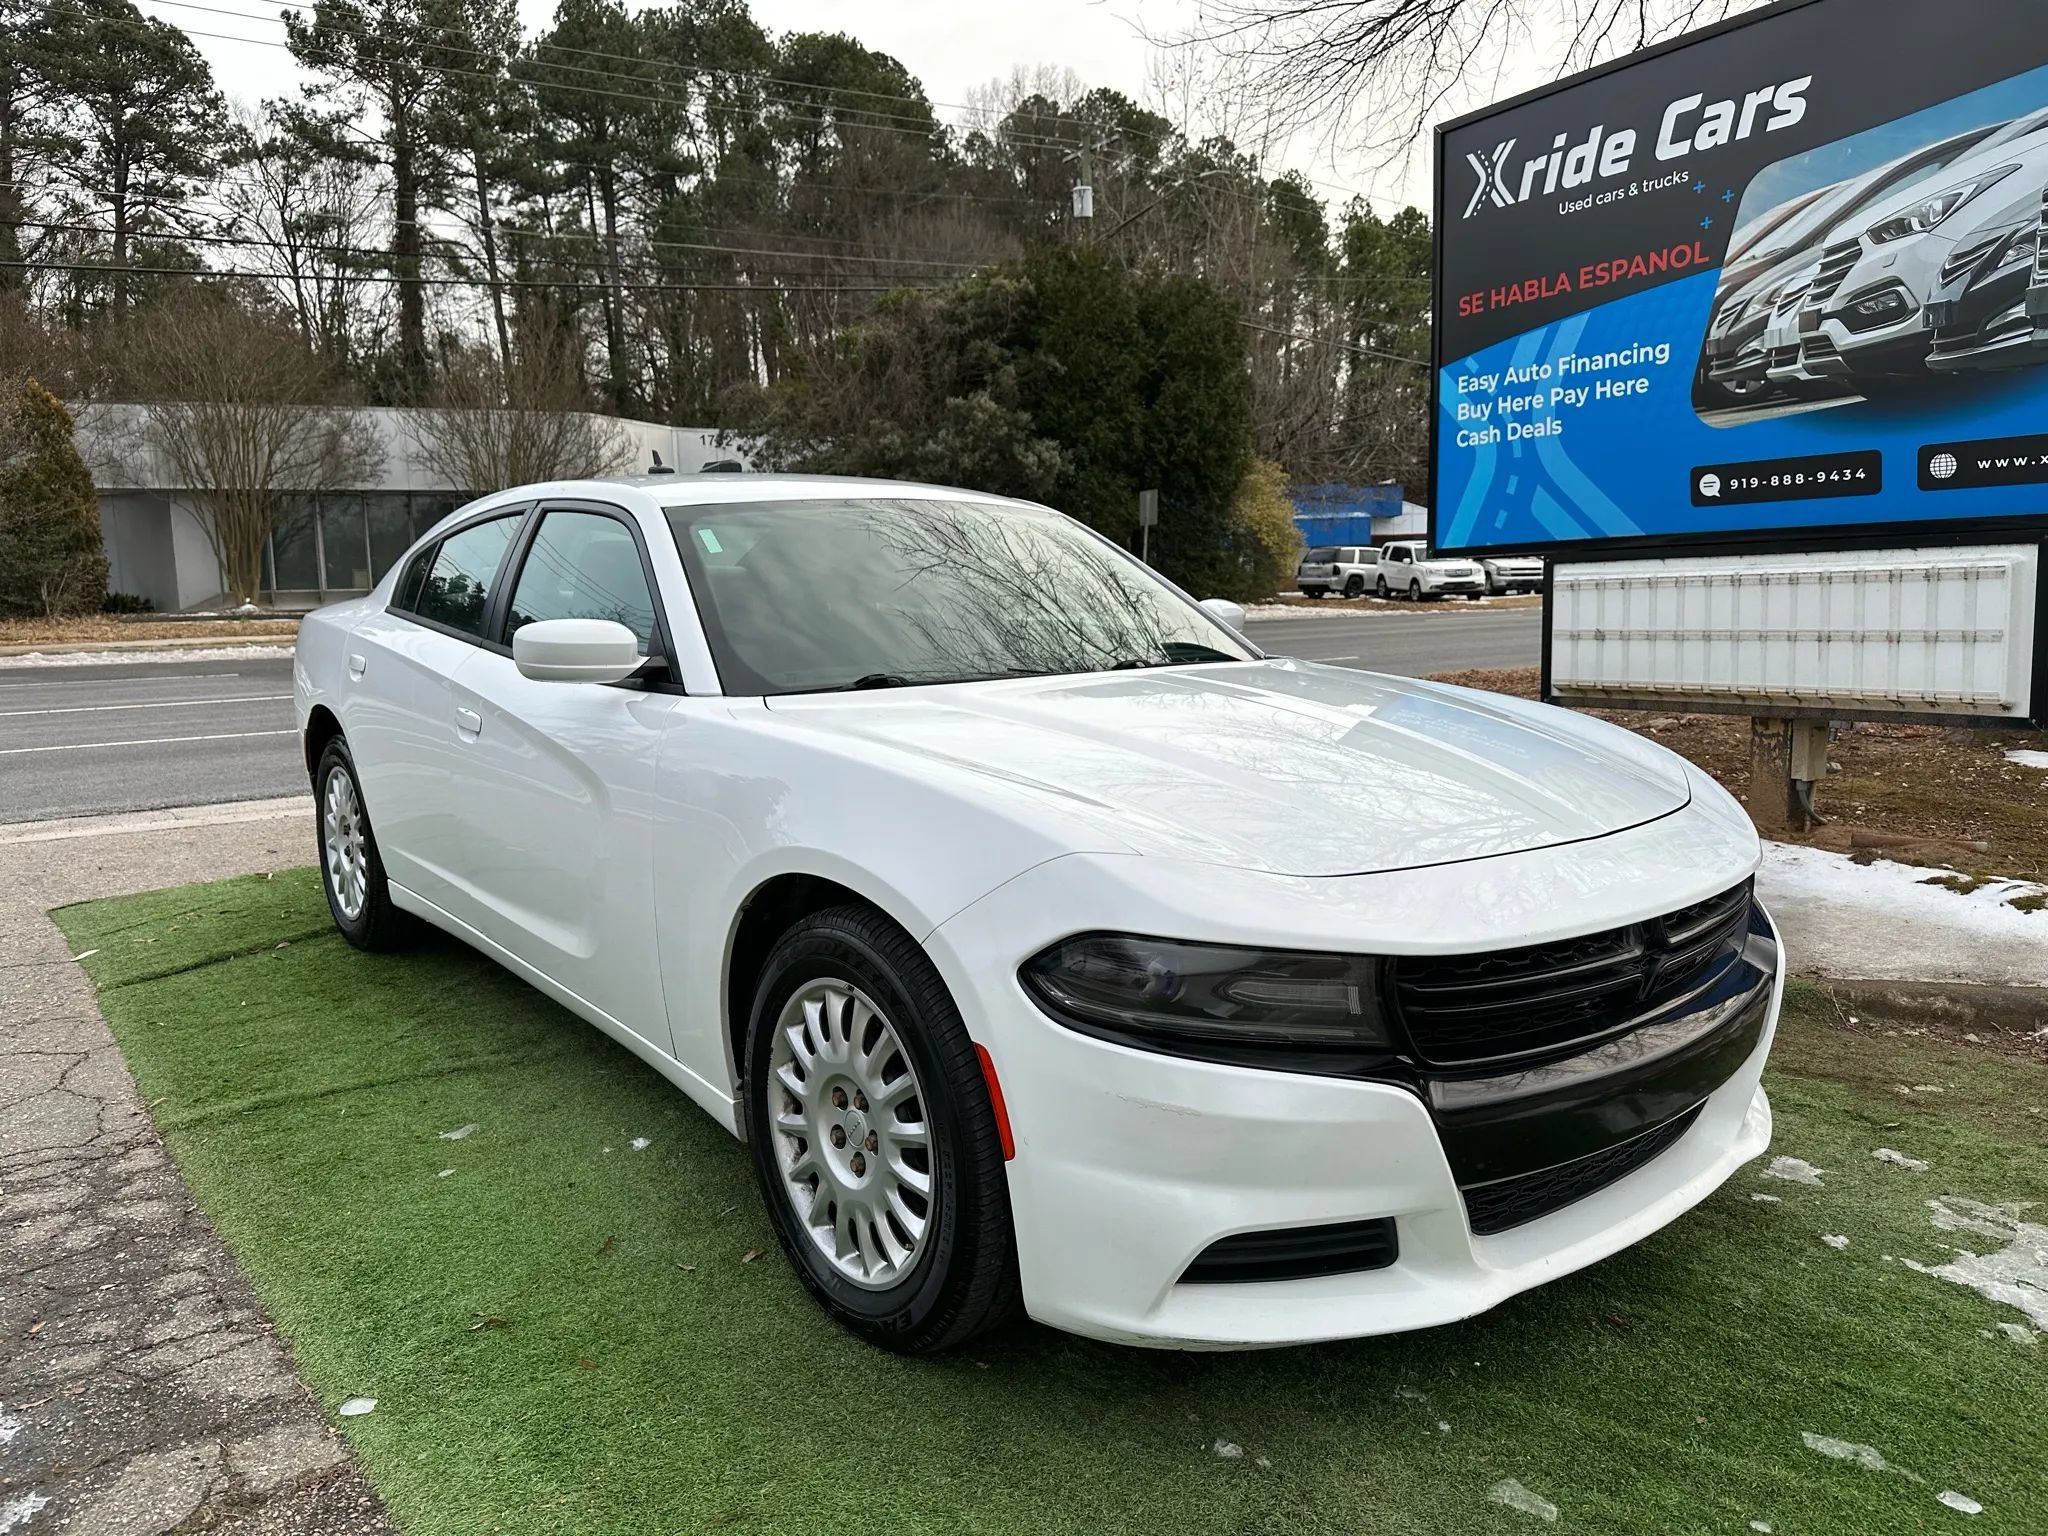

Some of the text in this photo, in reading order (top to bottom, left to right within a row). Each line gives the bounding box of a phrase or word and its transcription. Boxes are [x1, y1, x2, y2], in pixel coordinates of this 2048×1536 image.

[1655, 75, 1812, 162] Cars
[1558, 170, 1689, 215] Used cars & trucks
[1458, 241, 1709, 317] SE HABLA ESPANOL
[1457, 341, 1671, 393] Easy Auto Financing
[1457, 377, 1649, 421] Buy Here Pay Here
[699, 434, 733, 447] 172
[1456, 417, 1563, 448] Cash Deals
[1730, 468, 1866, 490] 919-888-9434
